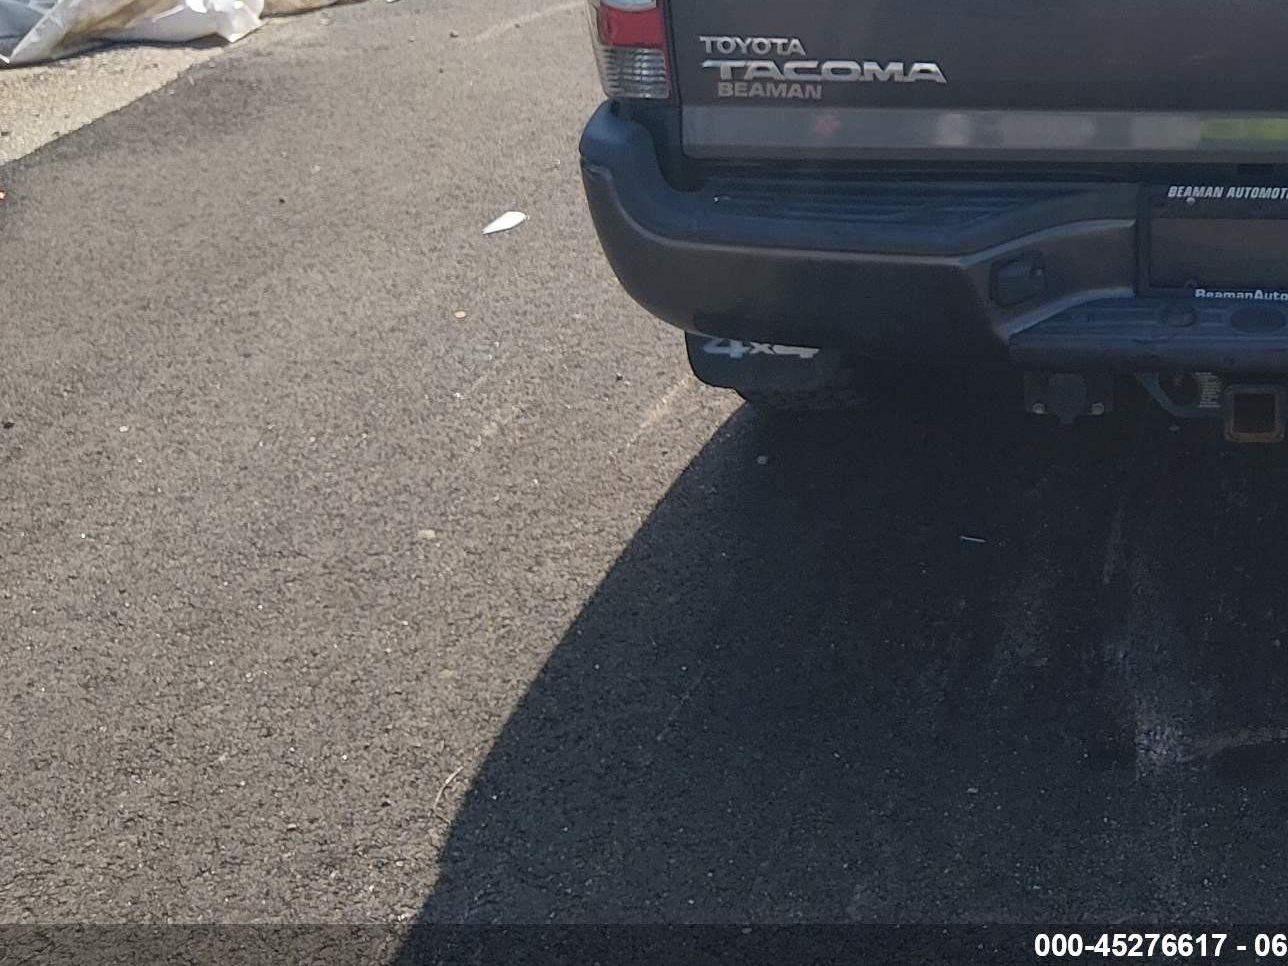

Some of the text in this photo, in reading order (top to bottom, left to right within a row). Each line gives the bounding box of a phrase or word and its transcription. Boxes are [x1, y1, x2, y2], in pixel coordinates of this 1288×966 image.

[699, 35, 806, 56] TOYOTA
[701, 59, 947, 83] TACOMA
[717, 82, 822, 100] BEAMAN
[1167, 185, 1224, 198] BEAMAN
